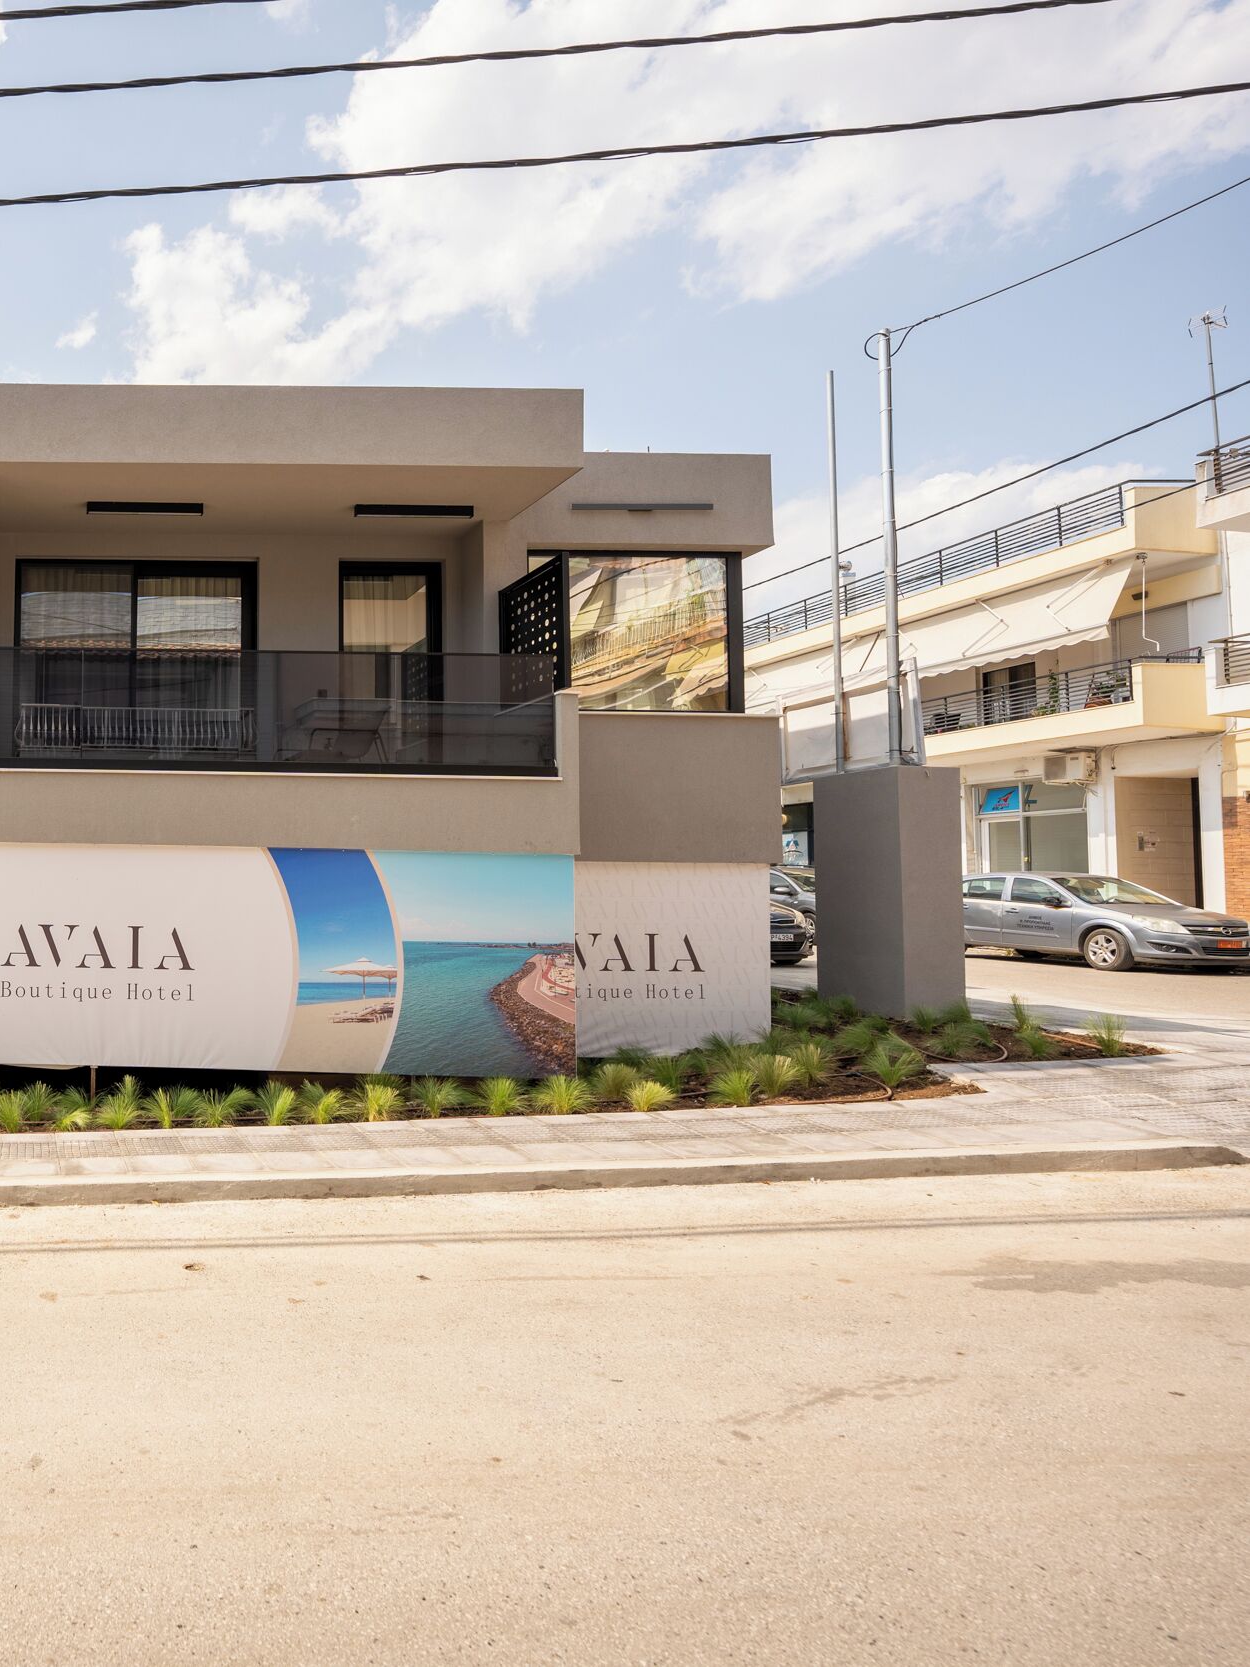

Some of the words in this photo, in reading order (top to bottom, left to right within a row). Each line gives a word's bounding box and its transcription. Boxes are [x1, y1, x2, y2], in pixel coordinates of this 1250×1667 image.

[0, 924, 195, 970] AVAIA
[0, 981, 112, 1002] Boutique
[127, 983, 195, 1001] Hotel
[646, 984, 706, 1000] Hotel
